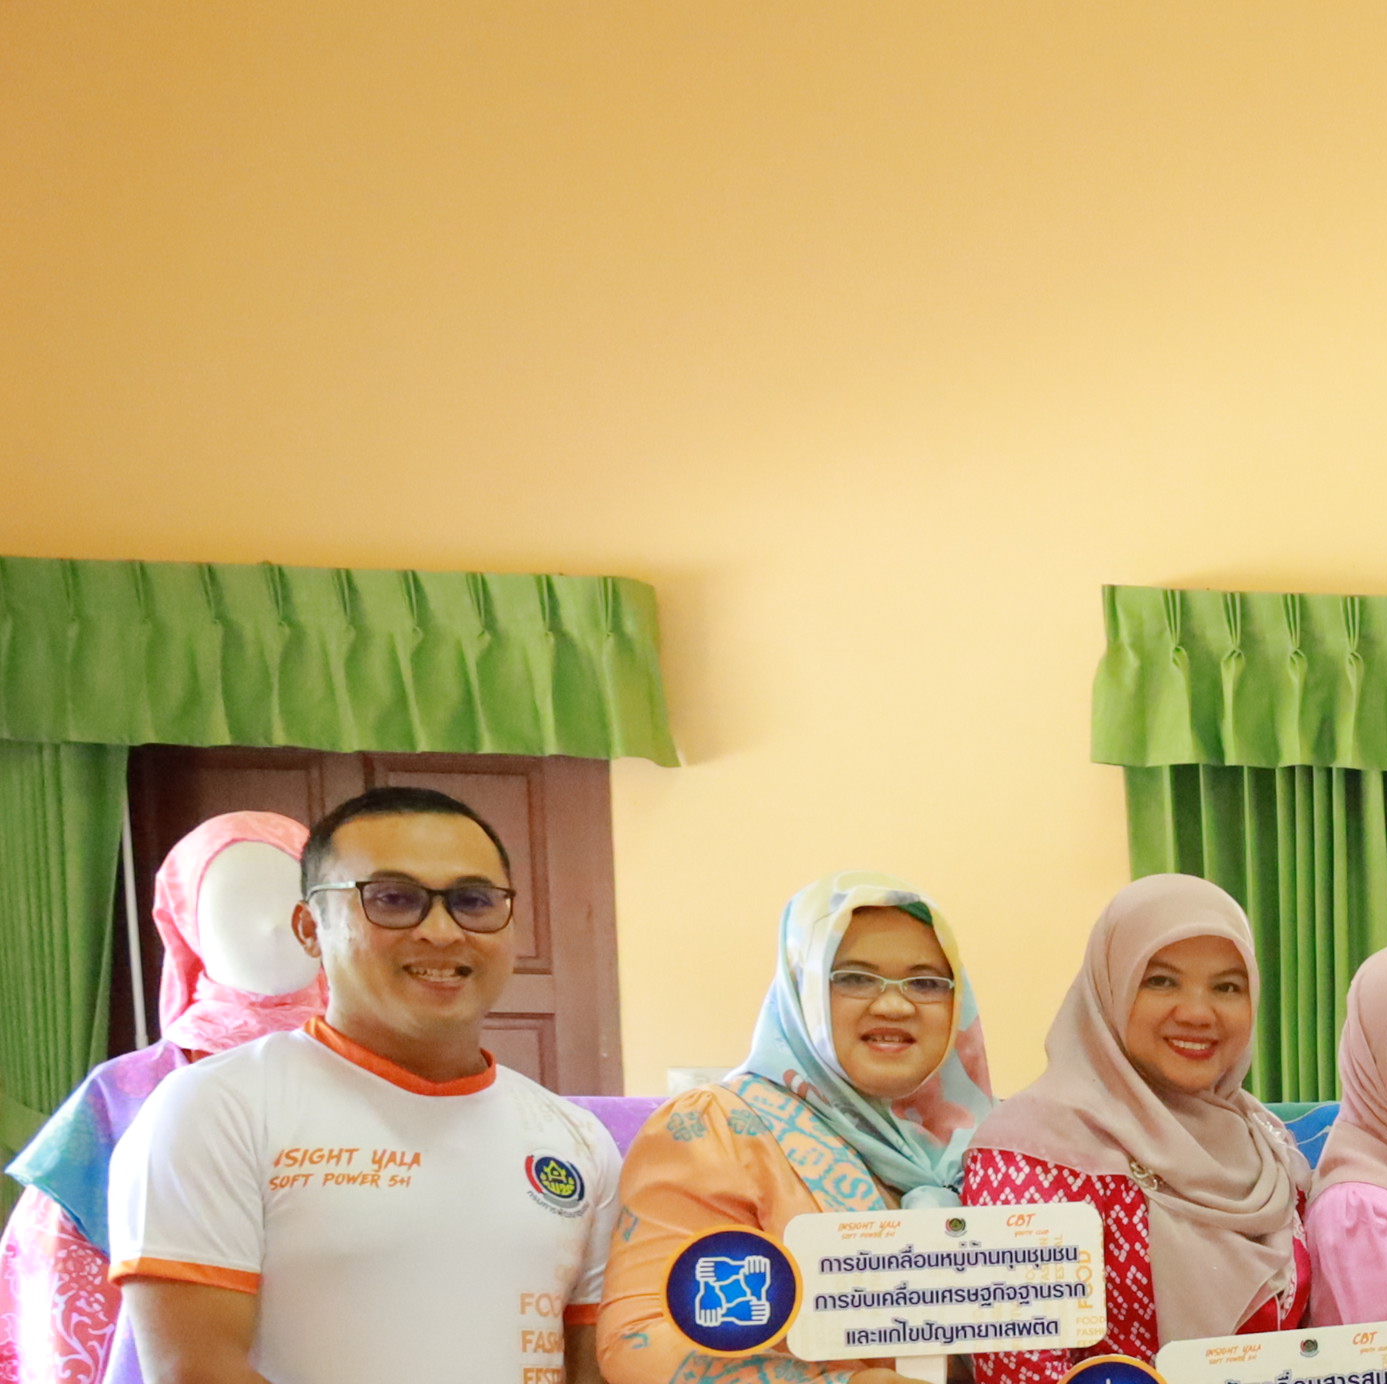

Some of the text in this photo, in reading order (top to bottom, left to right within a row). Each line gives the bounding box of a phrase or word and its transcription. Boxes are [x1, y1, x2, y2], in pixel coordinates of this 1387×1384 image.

[371, 1149, 422, 1173] YALA
[269, 1173, 314, 1191] SOFT
[322, 1171, 382, 1188] POWER
[1006, 1213, 1037, 1227] CBT
[820, 1242, 1078, 1272] การขับเคลื่อนหมู่บ้านทุนชุมชน
[815, 1282, 1087, 1309] การขับเคลื่อนเศรษฐกิจฐานราก
[1352, 1331, 1378, 1345] CBT
